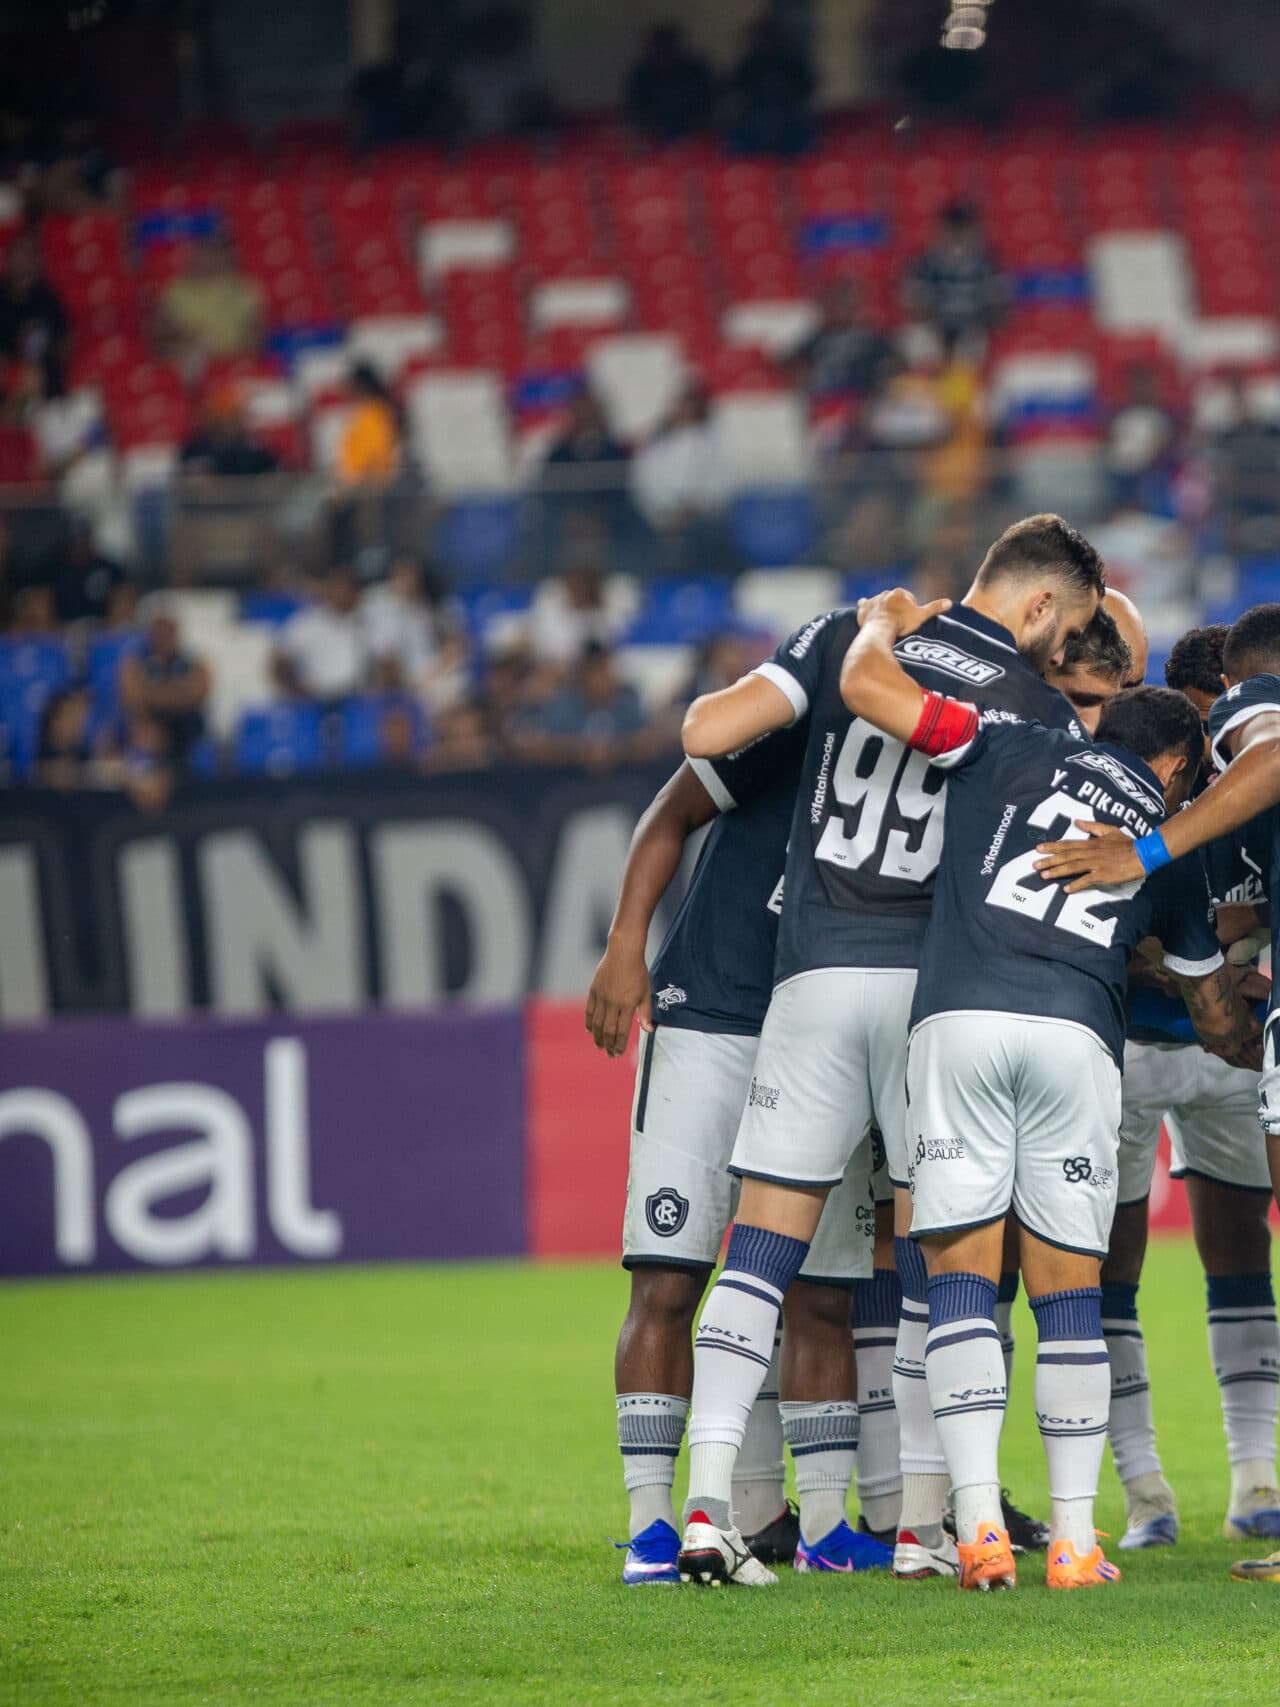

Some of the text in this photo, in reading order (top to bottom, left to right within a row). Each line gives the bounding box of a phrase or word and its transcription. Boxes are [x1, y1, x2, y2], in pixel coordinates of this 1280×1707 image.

[903, 640, 1001, 684] GAZIN
[812, 731, 836, 810] fatalmodel
[1050, 768, 1068, 790] Y.
[814, 717, 948, 884] 99
[698, 1324, 752, 1343] VOLT
